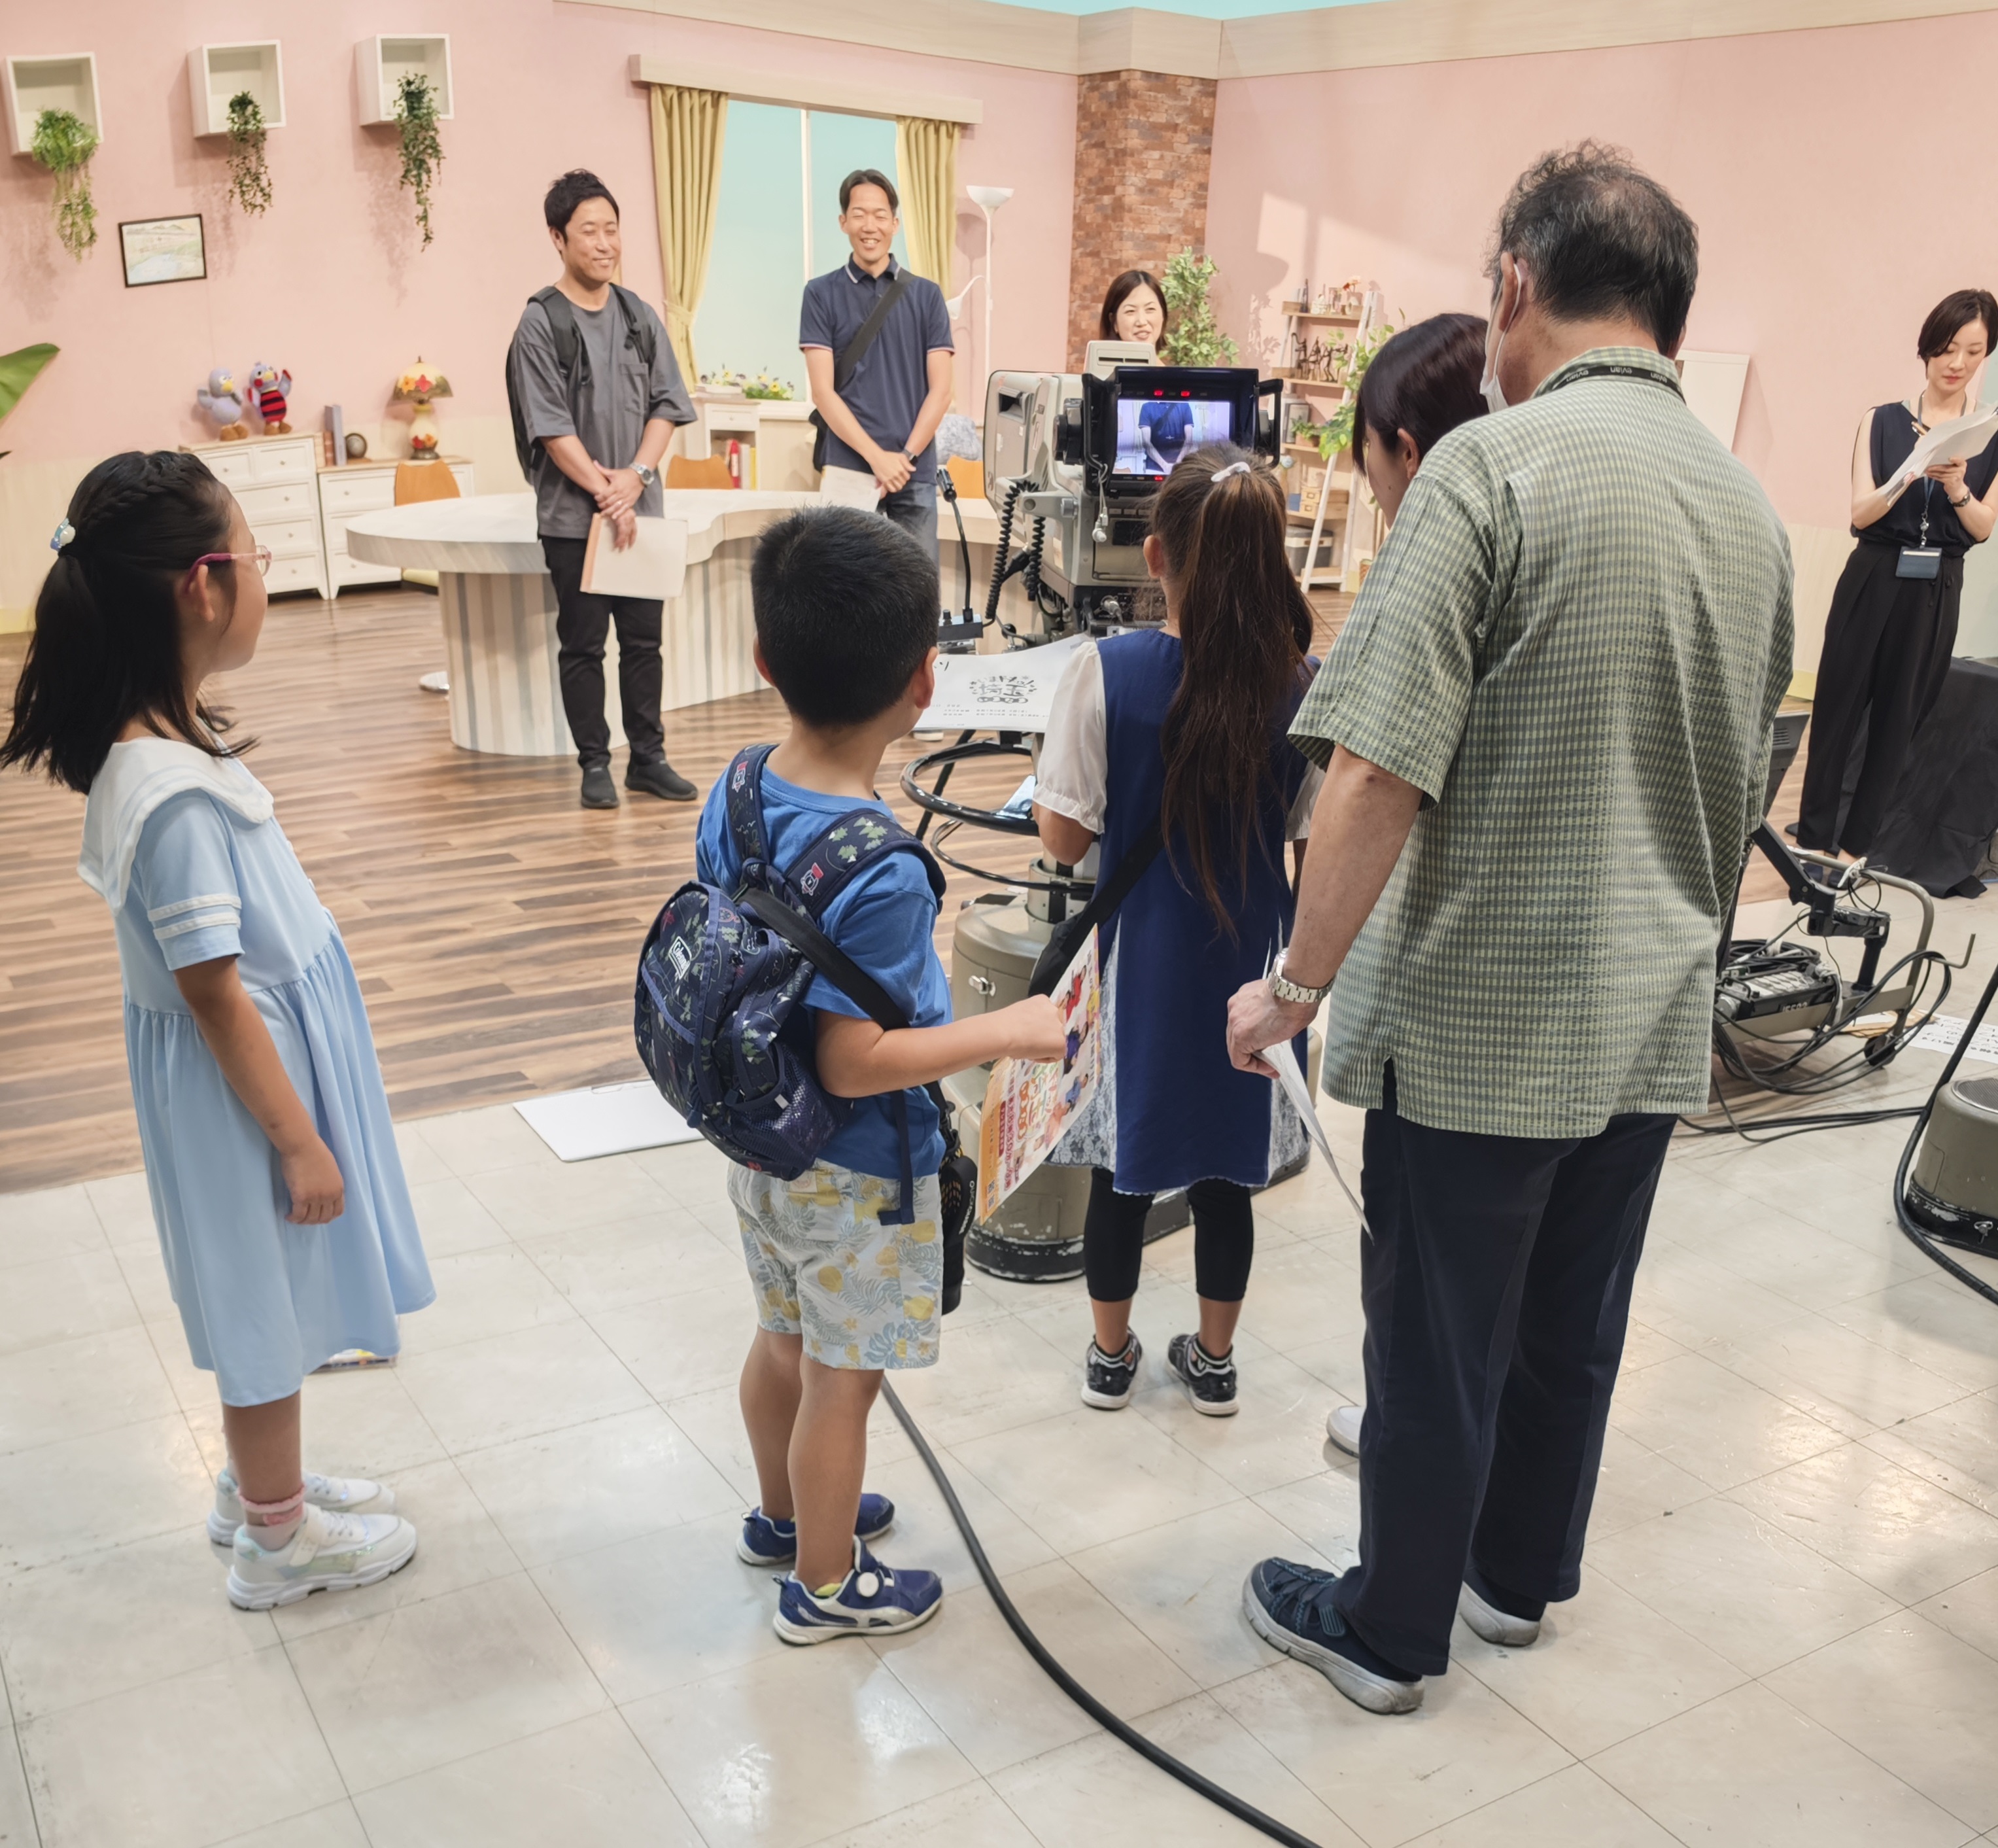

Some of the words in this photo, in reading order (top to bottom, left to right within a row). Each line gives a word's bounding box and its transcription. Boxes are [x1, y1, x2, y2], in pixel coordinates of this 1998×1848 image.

[1610, 366, 1632, 374] evian
[1566, 370, 1589, 382] evian
[1651, 372, 1667, 383] evian
